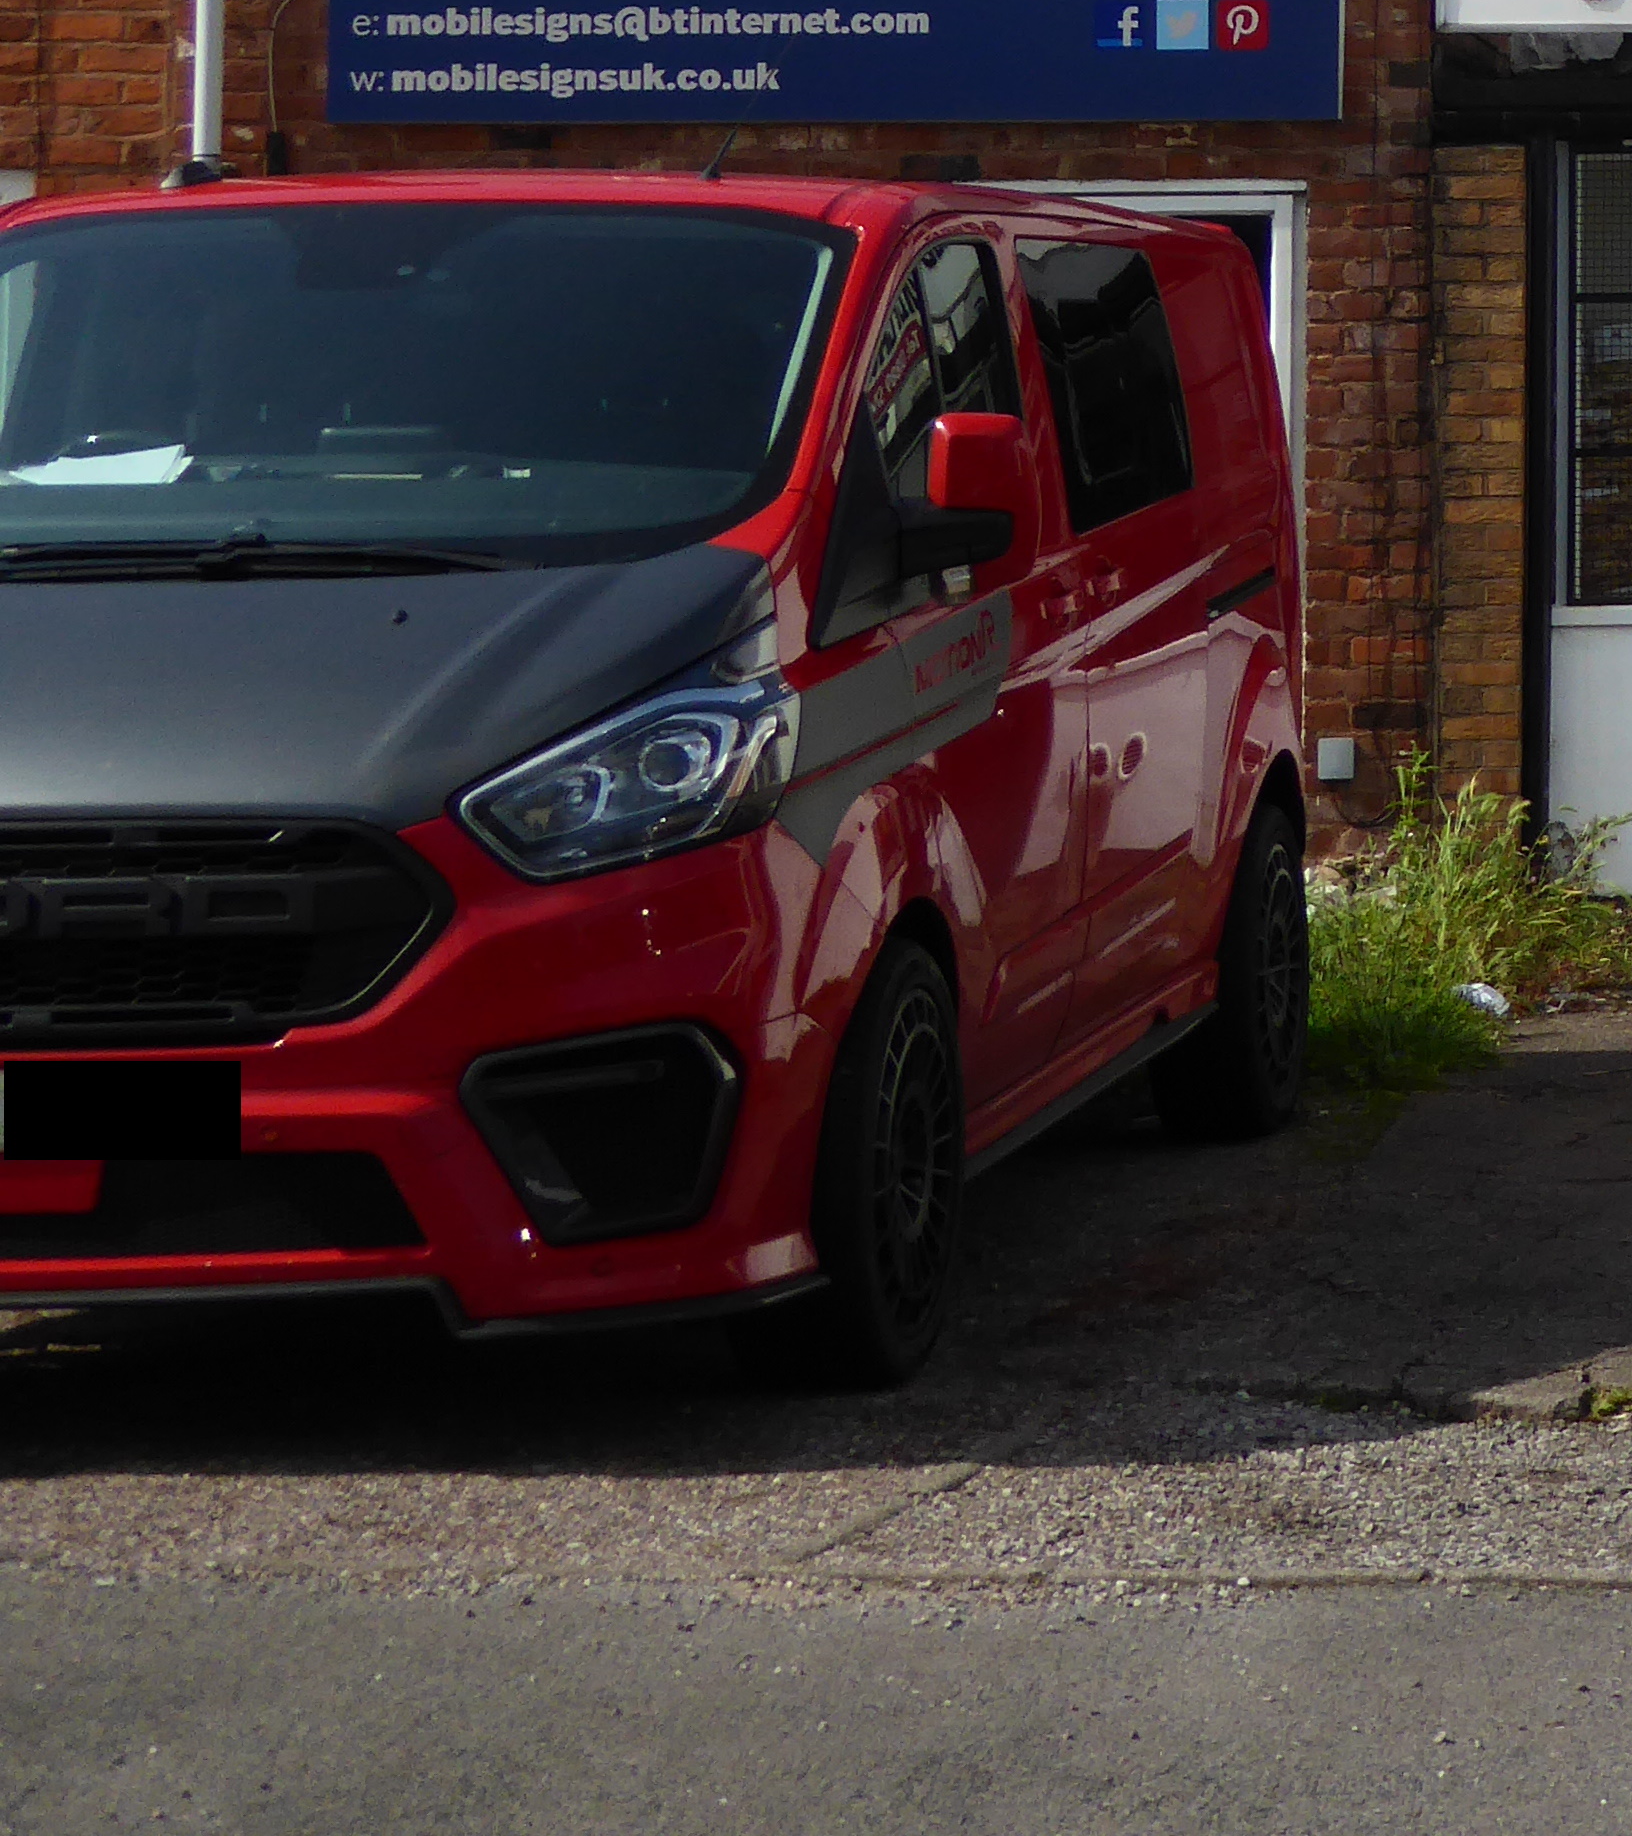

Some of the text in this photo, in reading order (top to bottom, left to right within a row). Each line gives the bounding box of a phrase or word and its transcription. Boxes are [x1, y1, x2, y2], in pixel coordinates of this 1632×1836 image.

[352, 6, 930, 42] e: mobilesigns@btinternet.com
[350, 62, 780, 98] w: mobilesignsuk.co.uk
